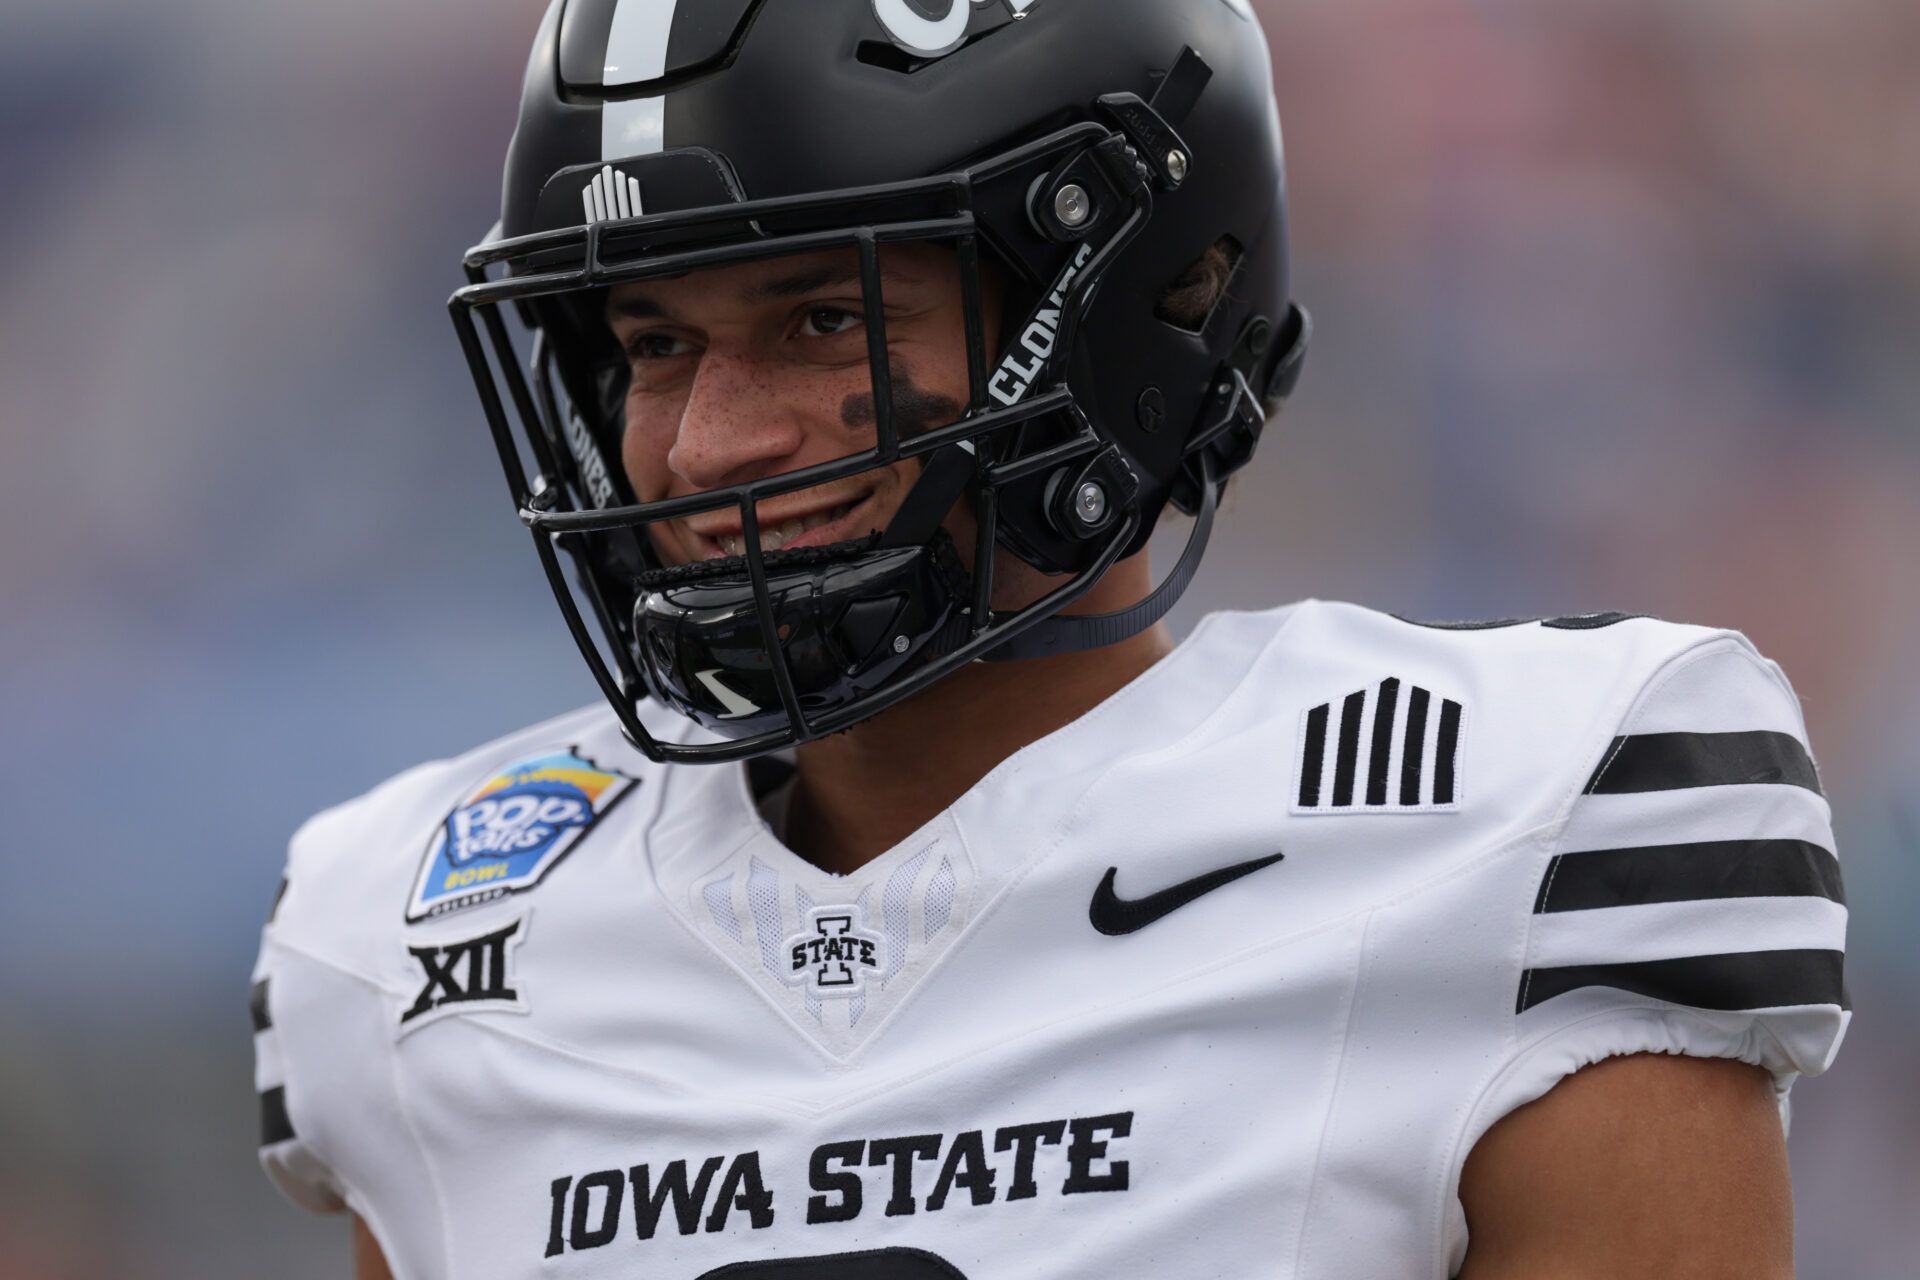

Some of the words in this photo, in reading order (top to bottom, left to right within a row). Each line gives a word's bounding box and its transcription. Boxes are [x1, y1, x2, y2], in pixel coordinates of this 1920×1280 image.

[444, 863, 509, 890] BOWL
[431, 888, 504, 916] ORLANDO
[791, 937, 877, 970] STATE
[401, 917, 521, 1024] XII
[543, 1150, 774, 1258] IOWA
[806, 1111, 1135, 1225] STATE
